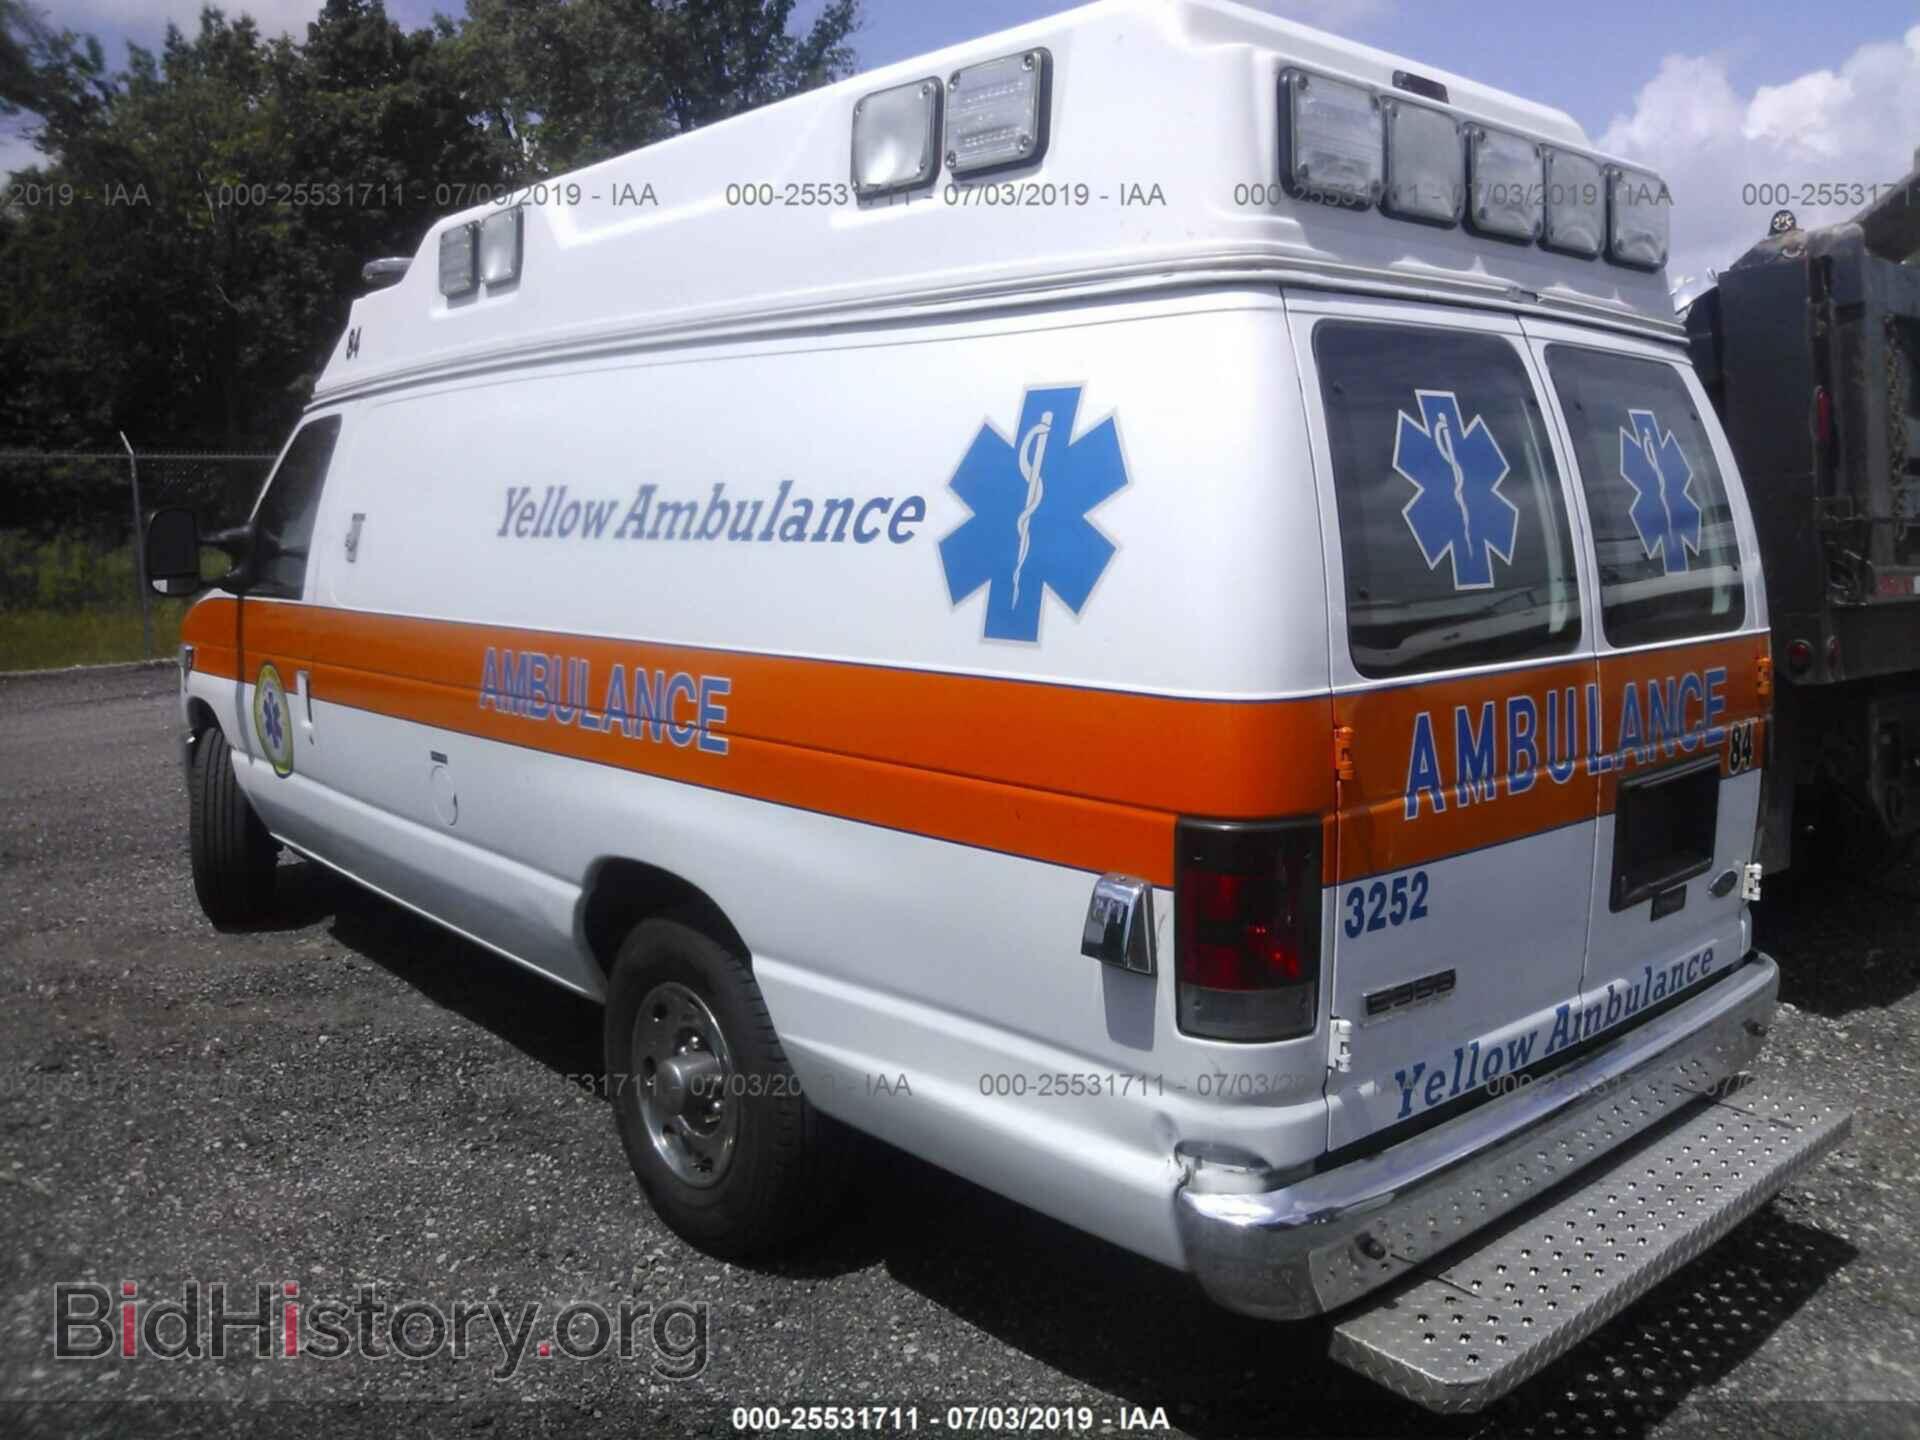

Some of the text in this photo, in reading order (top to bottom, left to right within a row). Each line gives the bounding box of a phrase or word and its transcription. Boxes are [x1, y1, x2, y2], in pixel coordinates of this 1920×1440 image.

[497, 479, 927, 545] Yellow Ambulance
[479, 646, 732, 755] AMBULANCE
[1404, 666, 1728, 821] AMBULANCE
[1728, 720, 1755, 775] 84
[1344, 870, 1430, 939] 3252
[1394, 946, 1715, 1119] Yellow Ambulance
